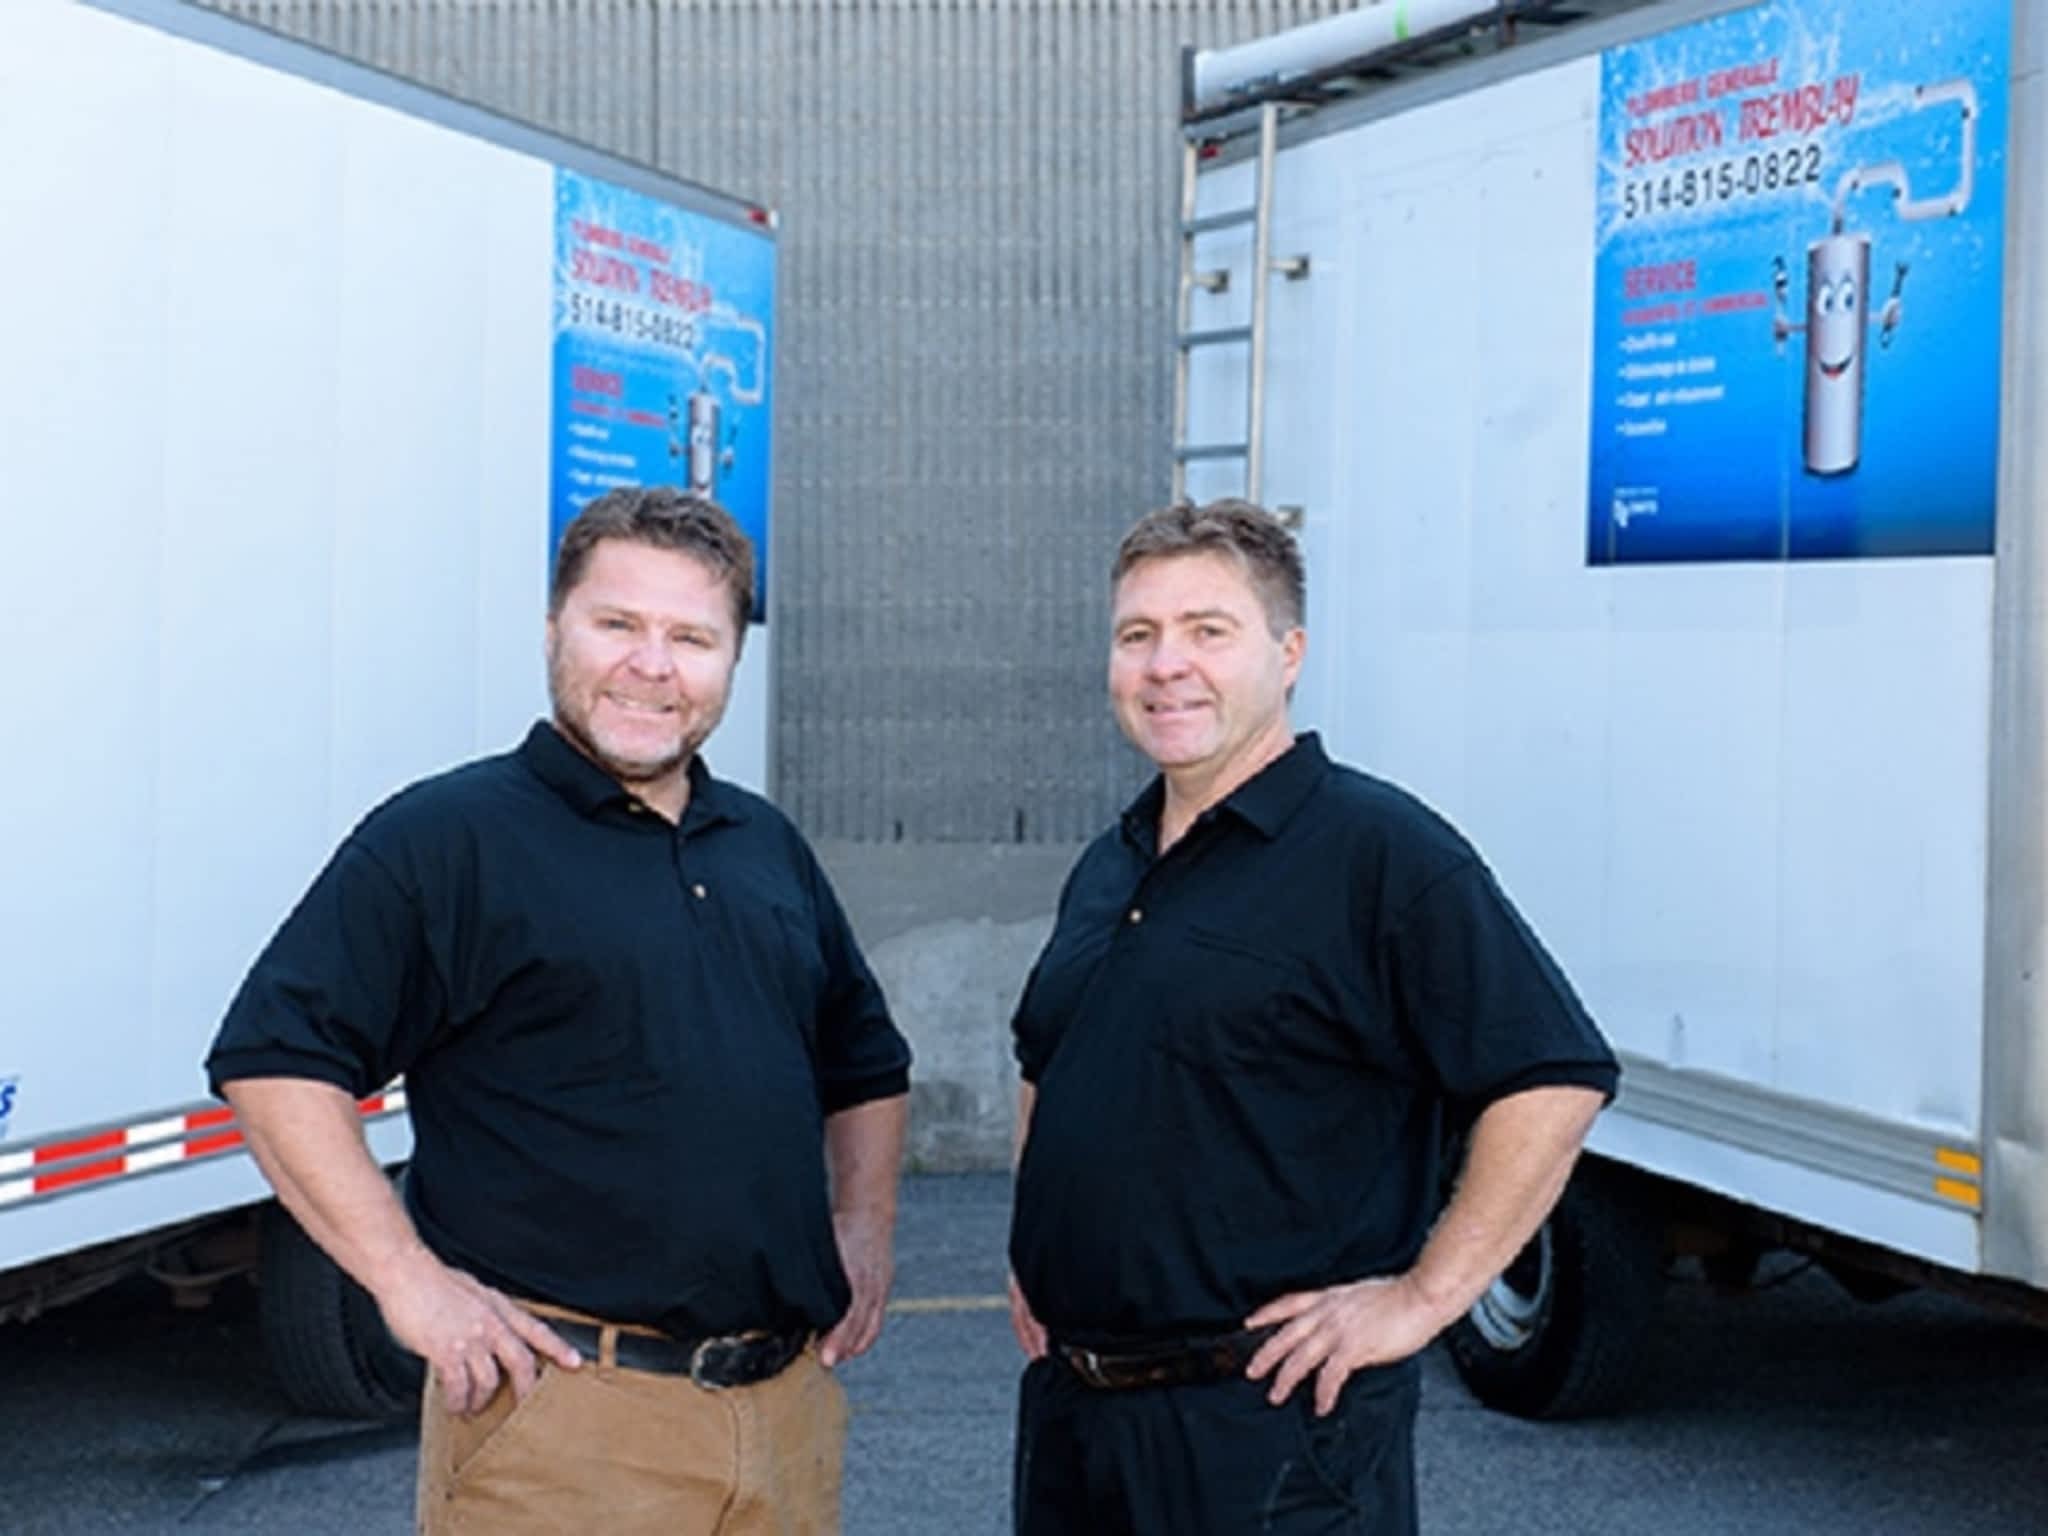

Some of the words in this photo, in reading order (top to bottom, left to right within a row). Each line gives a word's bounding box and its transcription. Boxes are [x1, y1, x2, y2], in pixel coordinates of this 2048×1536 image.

[1624, 110, 1722, 168] SOLUTION
[1739, 74, 1859, 142] TREMBLAY
[1623, 143, 1822, 220] 514-815-0822
[1624, 259, 1696, 298] SERVICE
